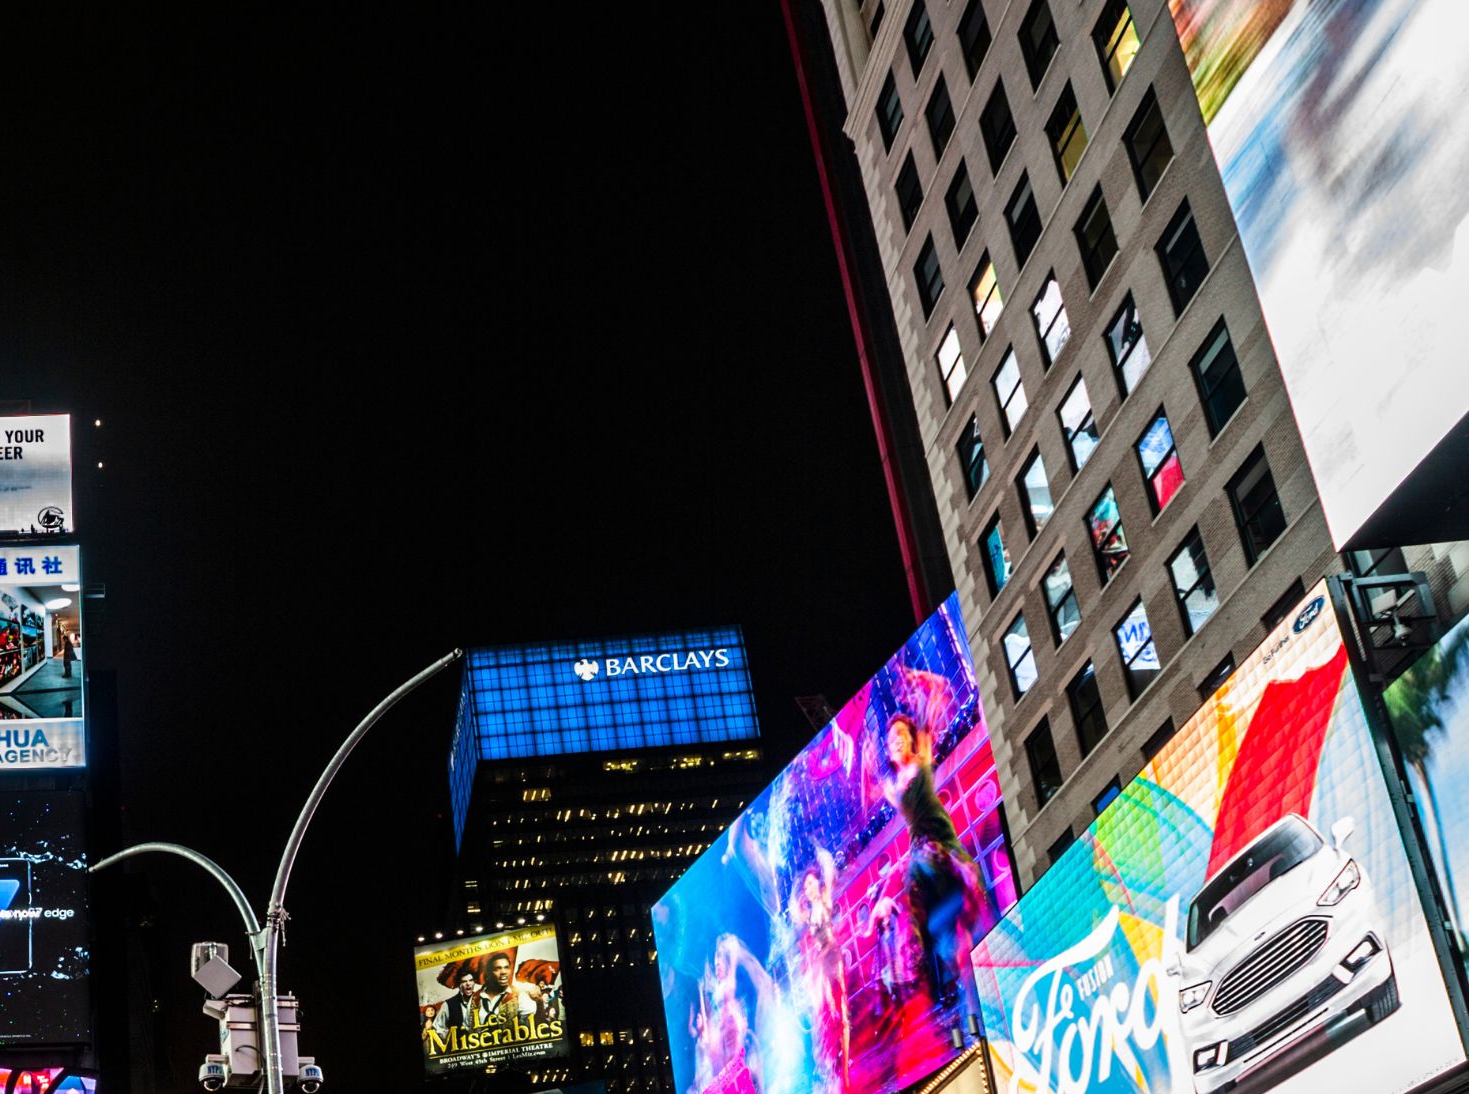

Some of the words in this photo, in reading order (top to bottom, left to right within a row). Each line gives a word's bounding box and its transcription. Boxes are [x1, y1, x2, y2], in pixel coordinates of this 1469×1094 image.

[5, 429, 44, 444] YOUR
[606, 649, 730, 676] BARCLAYS
[44, 908, 74, 921] edge
[418, 954, 443, 967] FINAL
[1077, 954, 1113, 998] FUSION
[473, 1008, 507, 1029] Les
[427, 1014, 563, 1055] Misérables
[440, 1053, 480, 1065] BROADWAY'S
[488, 1048, 519, 1057] IMPERIAL
[521, 1042, 553, 1052] THEATRE
